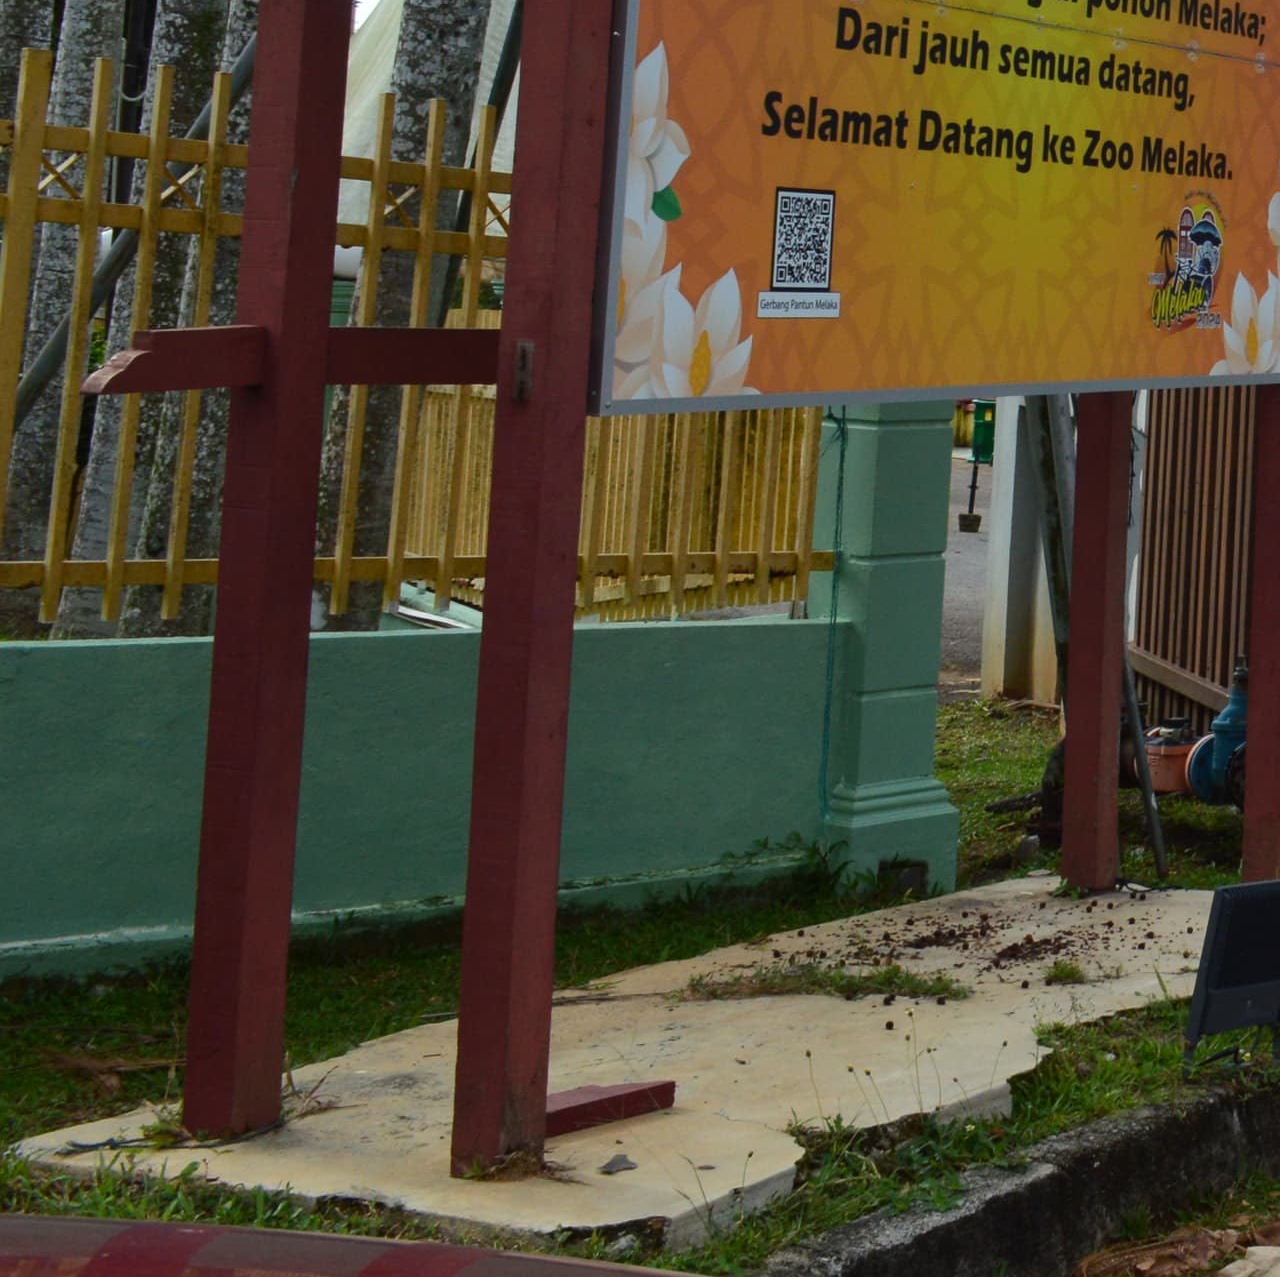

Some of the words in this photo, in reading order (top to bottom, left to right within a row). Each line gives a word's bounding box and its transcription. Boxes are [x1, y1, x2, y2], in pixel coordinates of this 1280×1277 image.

[835, 6, 910, 60] Dari
[913, 20, 990, 75] jauh
[998, 43, 1091, 87] semua
[1098, 53, 1196, 112] datang,
[761, 90, 909, 150] Selamat
[918, 109, 1034, 174] Datang
[1042, 124, 1076, 165] ke
[1082, 128, 1134, 170] Zoo
[1141, 136, 1233, 181] Melaka.
[760, 298, 789, 313] Gerbang
[790, 299, 814, 310] Pantun
[815, 299, 838, 311] Melaka
